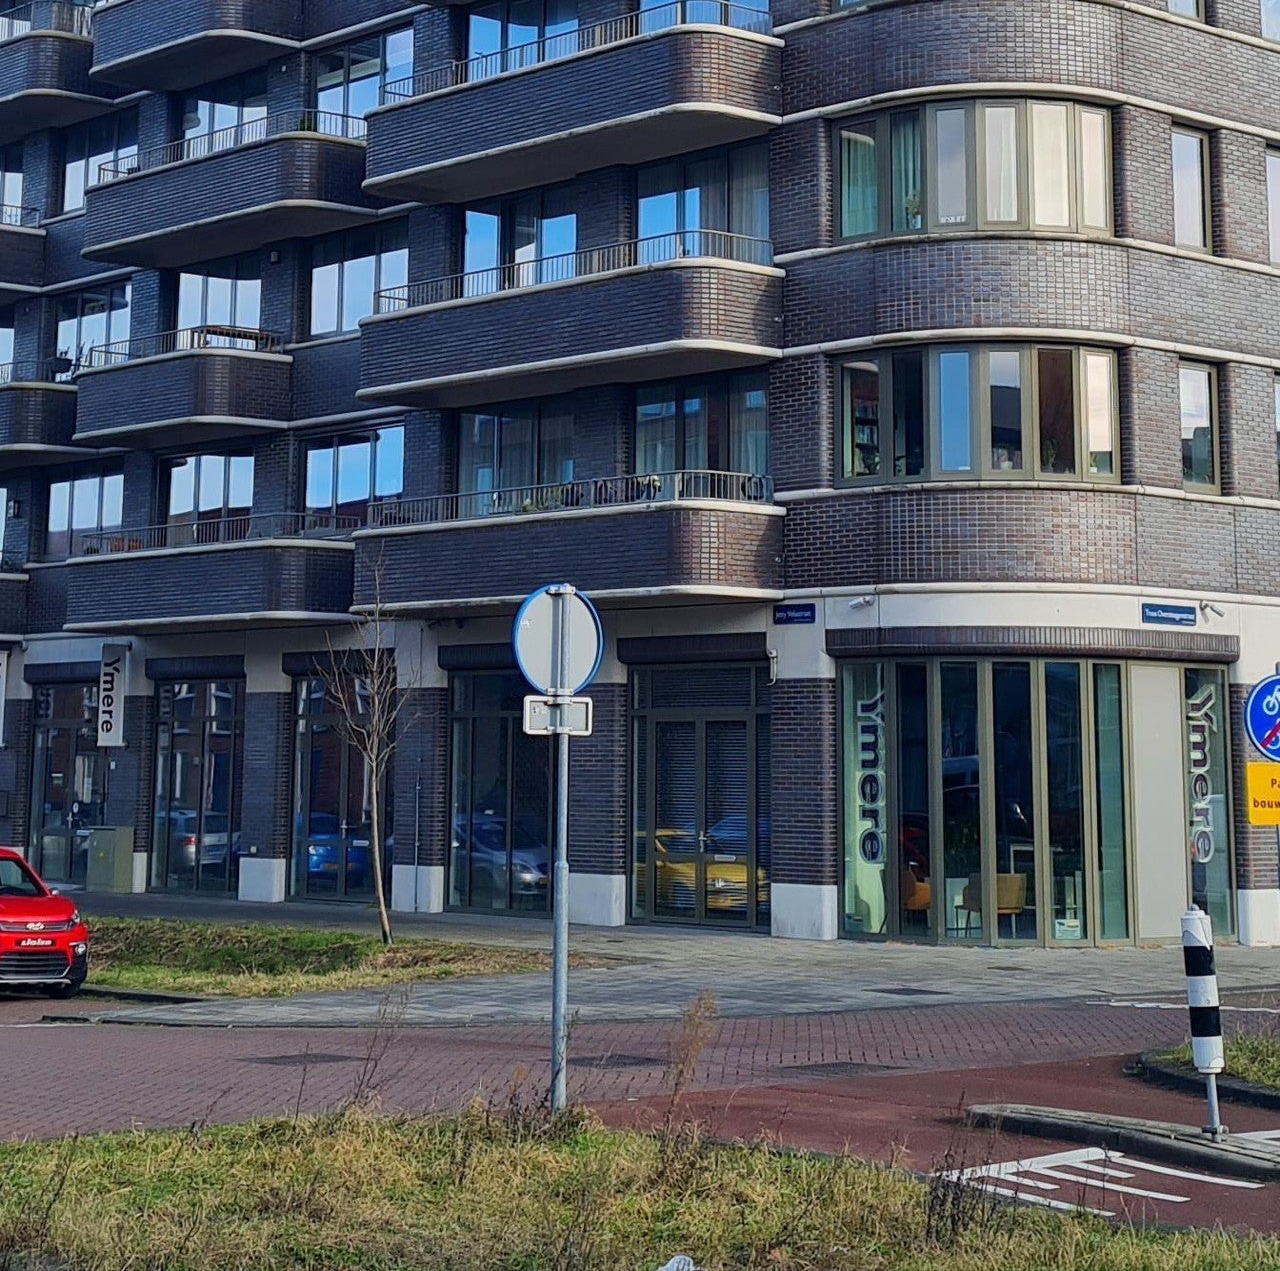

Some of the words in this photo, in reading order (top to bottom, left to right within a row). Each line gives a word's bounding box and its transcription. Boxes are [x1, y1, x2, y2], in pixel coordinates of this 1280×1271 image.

[101, 657, 121, 733] Ymere
[857, 691, 886, 864] Ymere
[1189, 685, 1217, 863] Ymere
